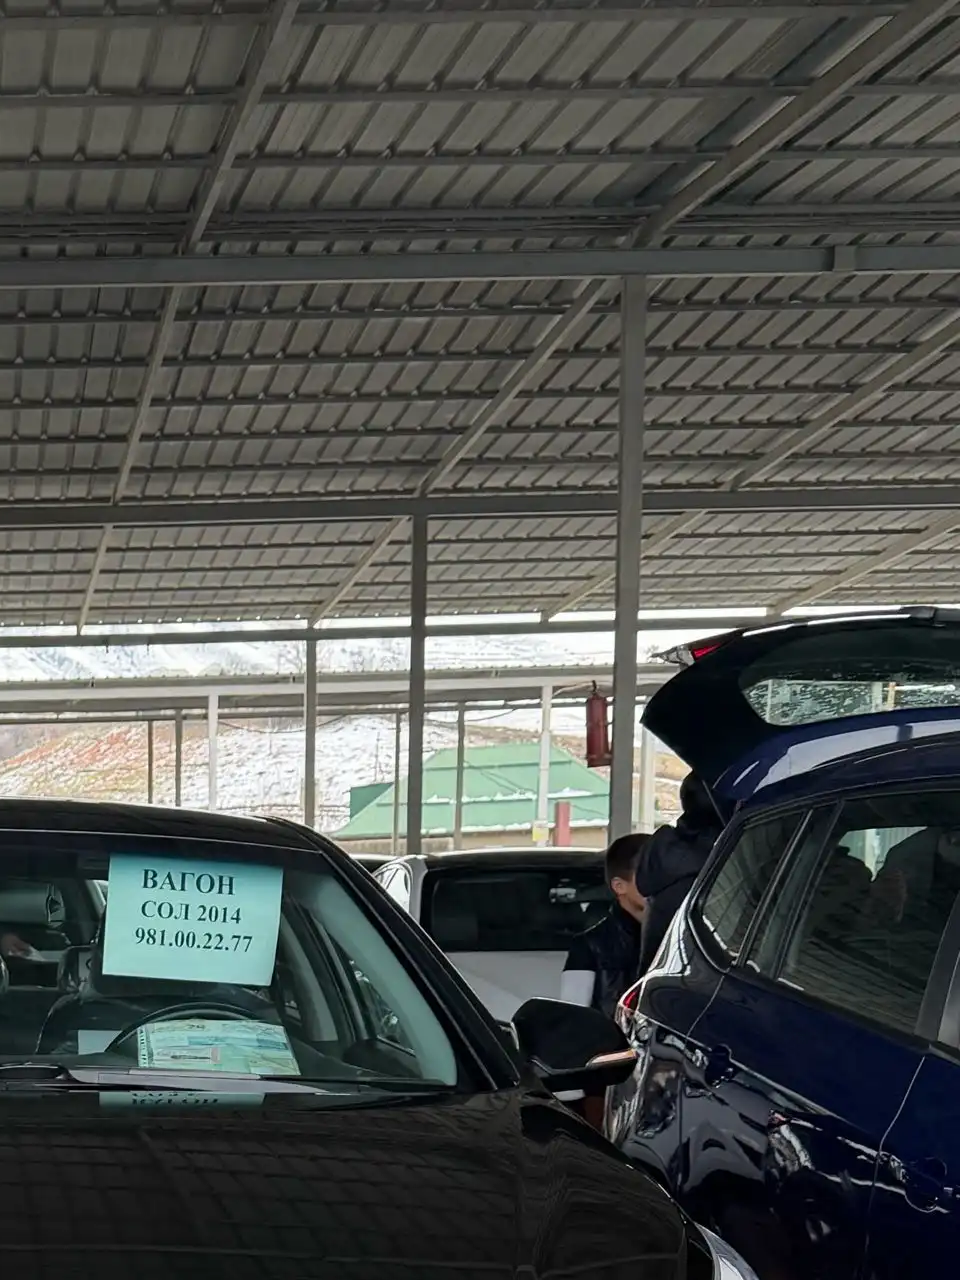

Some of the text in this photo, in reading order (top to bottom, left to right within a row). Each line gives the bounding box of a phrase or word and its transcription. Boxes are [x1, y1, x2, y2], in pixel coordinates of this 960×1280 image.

[142, 868, 235, 896] ВАГОН
[141, 900, 241, 924] СОЛ 2014
[135, 927, 253, 953] 981.00.22.77
